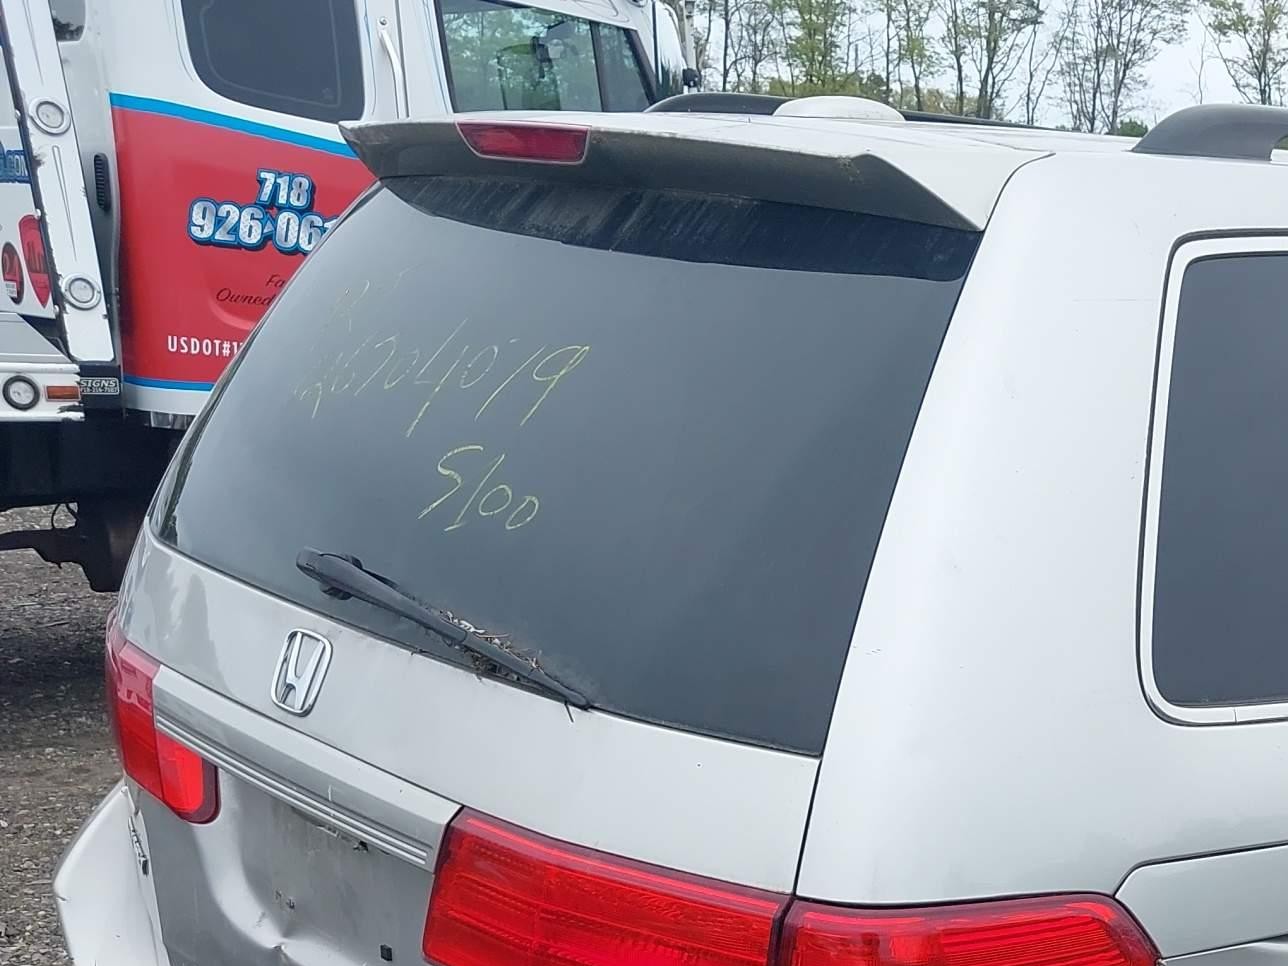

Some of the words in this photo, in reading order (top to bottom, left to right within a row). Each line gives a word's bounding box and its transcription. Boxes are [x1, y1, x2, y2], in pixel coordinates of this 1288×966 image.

[257, 170, 311, 208] 718
[167, 335, 243, 357] USDOT#1
[80, 379, 116, 387] SIGNS
